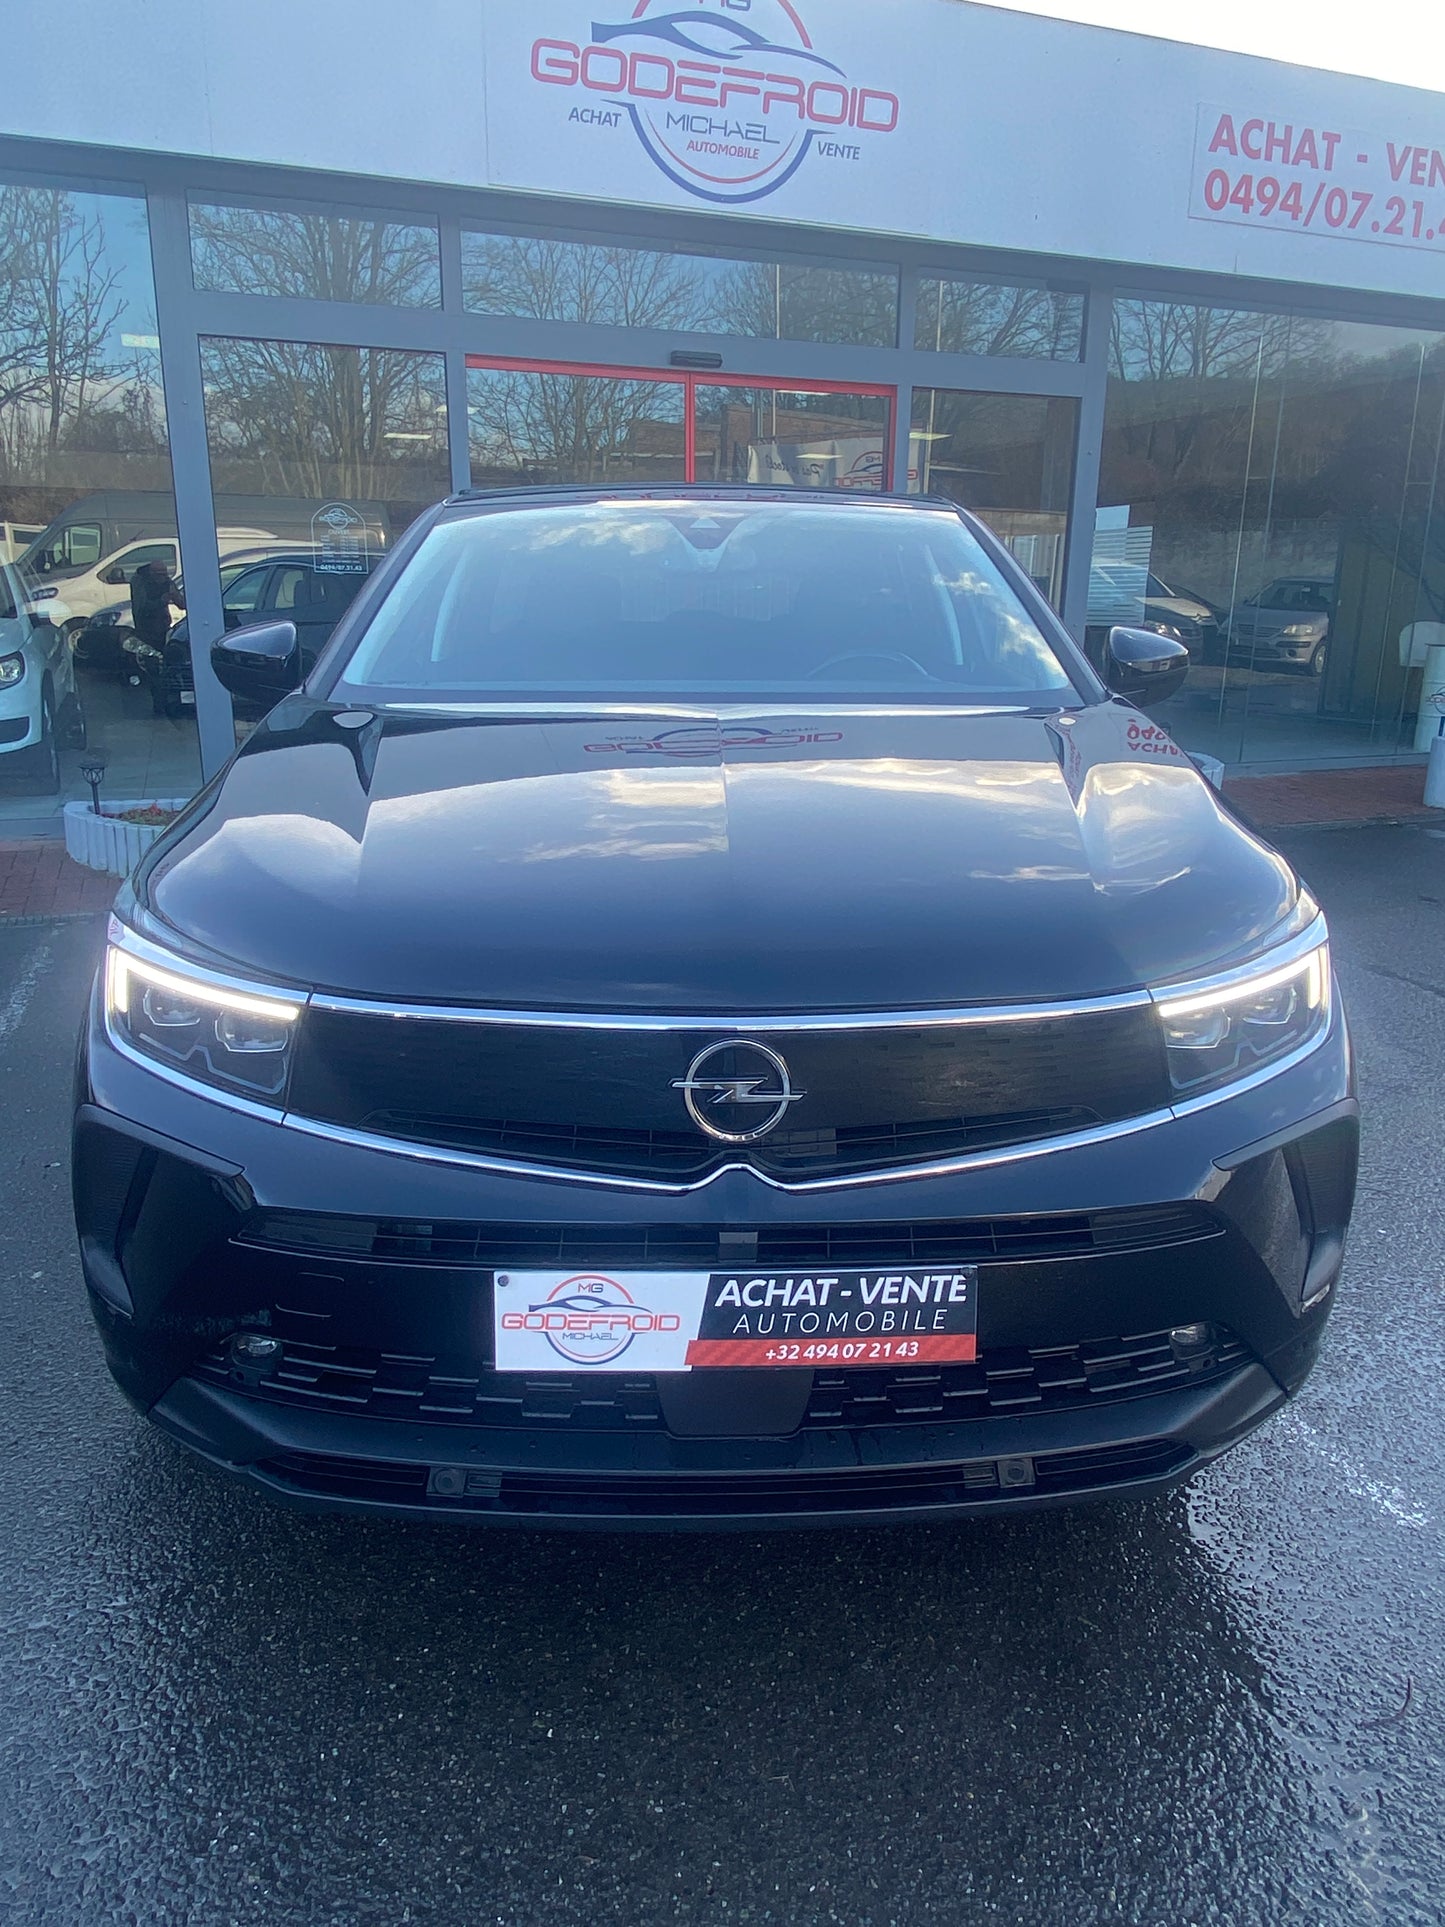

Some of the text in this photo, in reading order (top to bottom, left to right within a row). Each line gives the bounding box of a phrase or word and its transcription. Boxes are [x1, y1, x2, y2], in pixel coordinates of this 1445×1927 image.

[530, 38, 899, 133] GODEFROID
[568, 106, 622, 129] ACHAT
[666, 111, 780, 144] MICHAEL
[686, 139, 760, 160] AUTOMOBILE
[817, 141, 861, 161] VENTE
[1208, 113, 1342, 171] ACHAT
[1204, 168, 1445, 240] 0494/07.21.
[578, 1283, 604, 1293] MG
[714, 1278, 838, 1307] ACHAT
[860, 1274, 968, 1305] VENTE
[501, 1312, 680, 1331] GODEFROID
[732, 1309, 948, 1334] AUTOMOBILE
[562, 1331, 619, 1341] MICHAEL
[765, 1341, 919, 1360] +32 494 07 21 43
